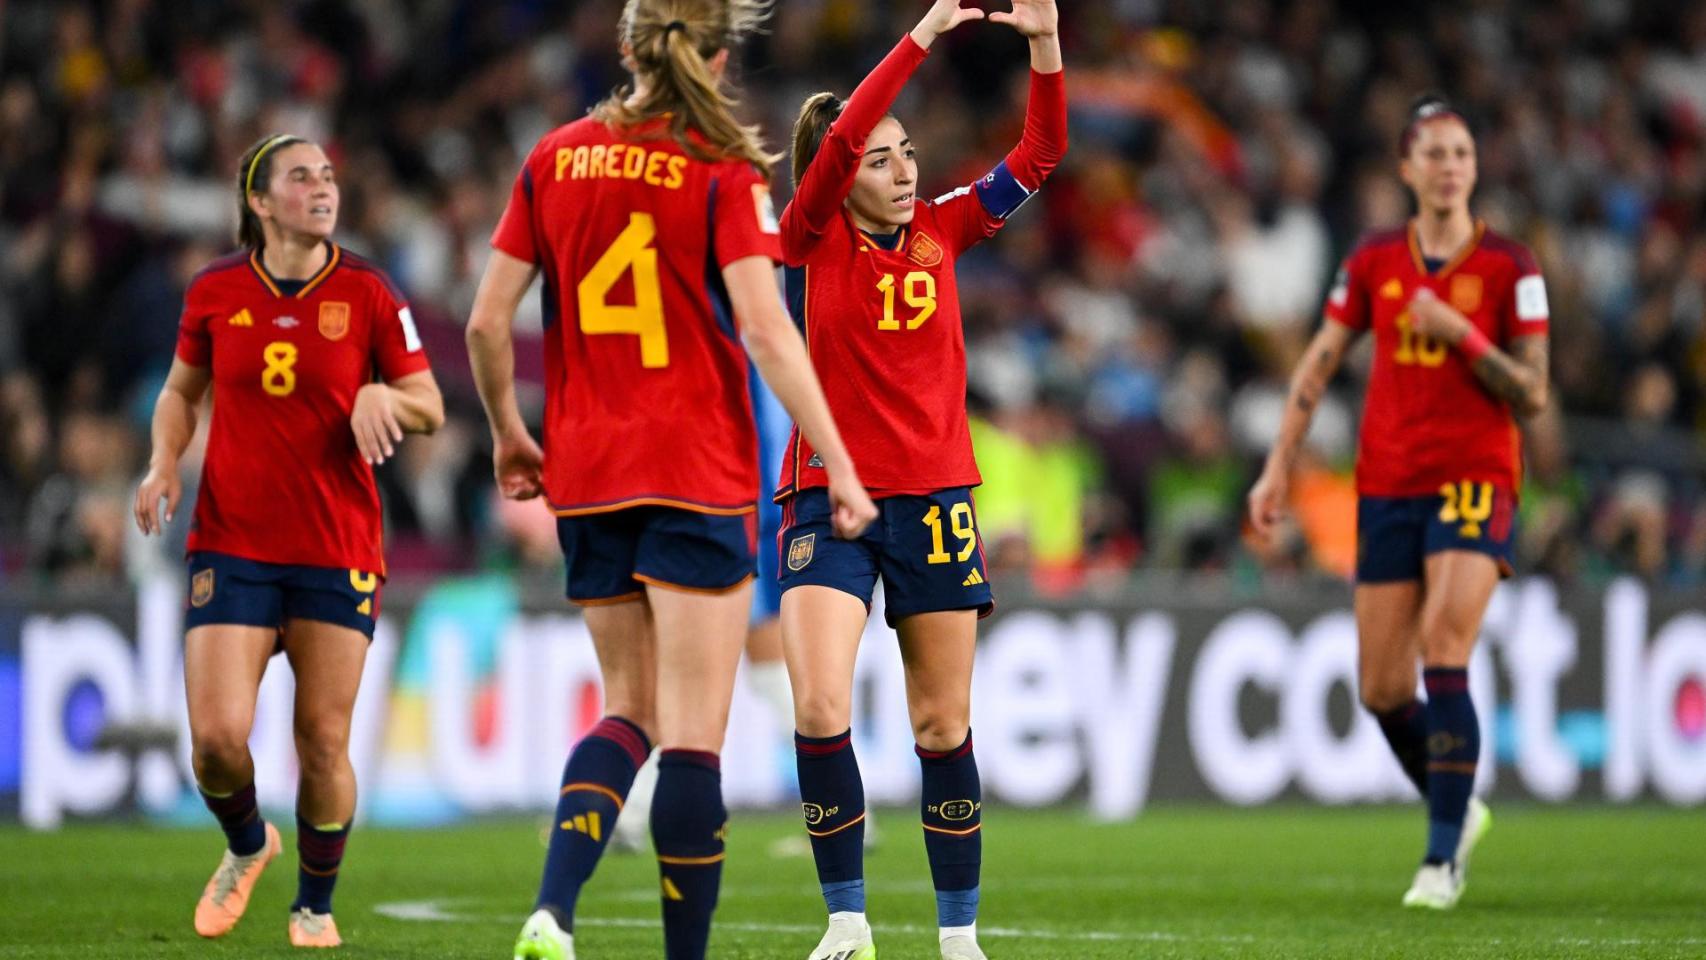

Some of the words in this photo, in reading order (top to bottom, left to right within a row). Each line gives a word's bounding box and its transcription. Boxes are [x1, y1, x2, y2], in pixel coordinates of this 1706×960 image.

[555, 144, 688, 190] PAREDES
[577, 212, 670, 369] 4
[876, 271, 937, 330] 19
[261, 341, 298, 396] 8
[922, 502, 977, 565] 19
